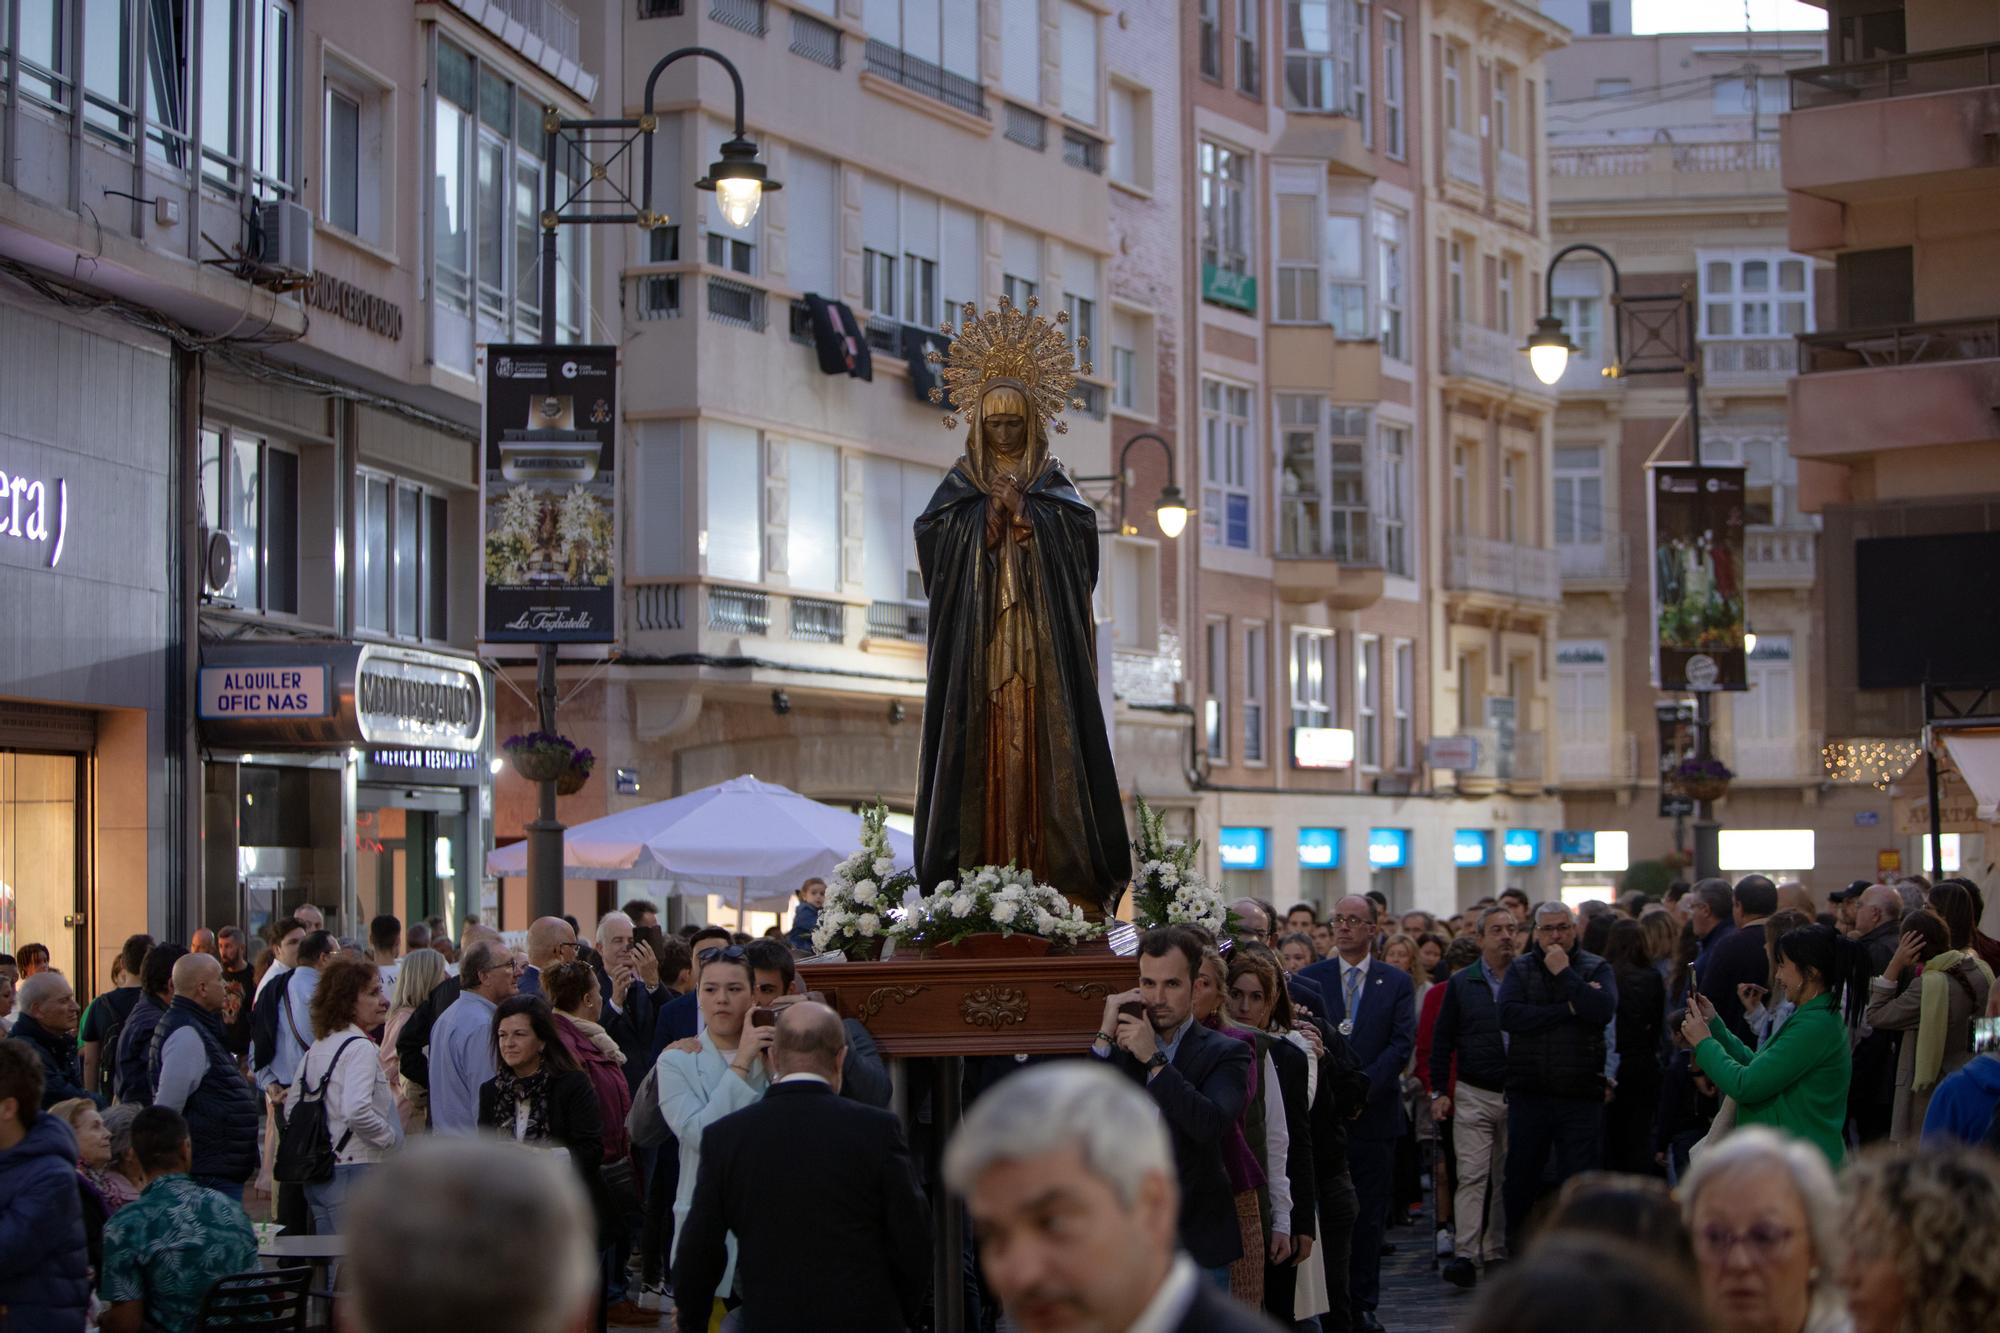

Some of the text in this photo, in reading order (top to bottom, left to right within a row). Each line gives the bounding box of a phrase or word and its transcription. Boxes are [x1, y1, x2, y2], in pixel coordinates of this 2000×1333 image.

[339, 281, 367, 327] CERO
[366, 293, 403, 342] RADIO
[505, 611, 529, 630] La
[224, 672, 301, 690] ALQUILER
